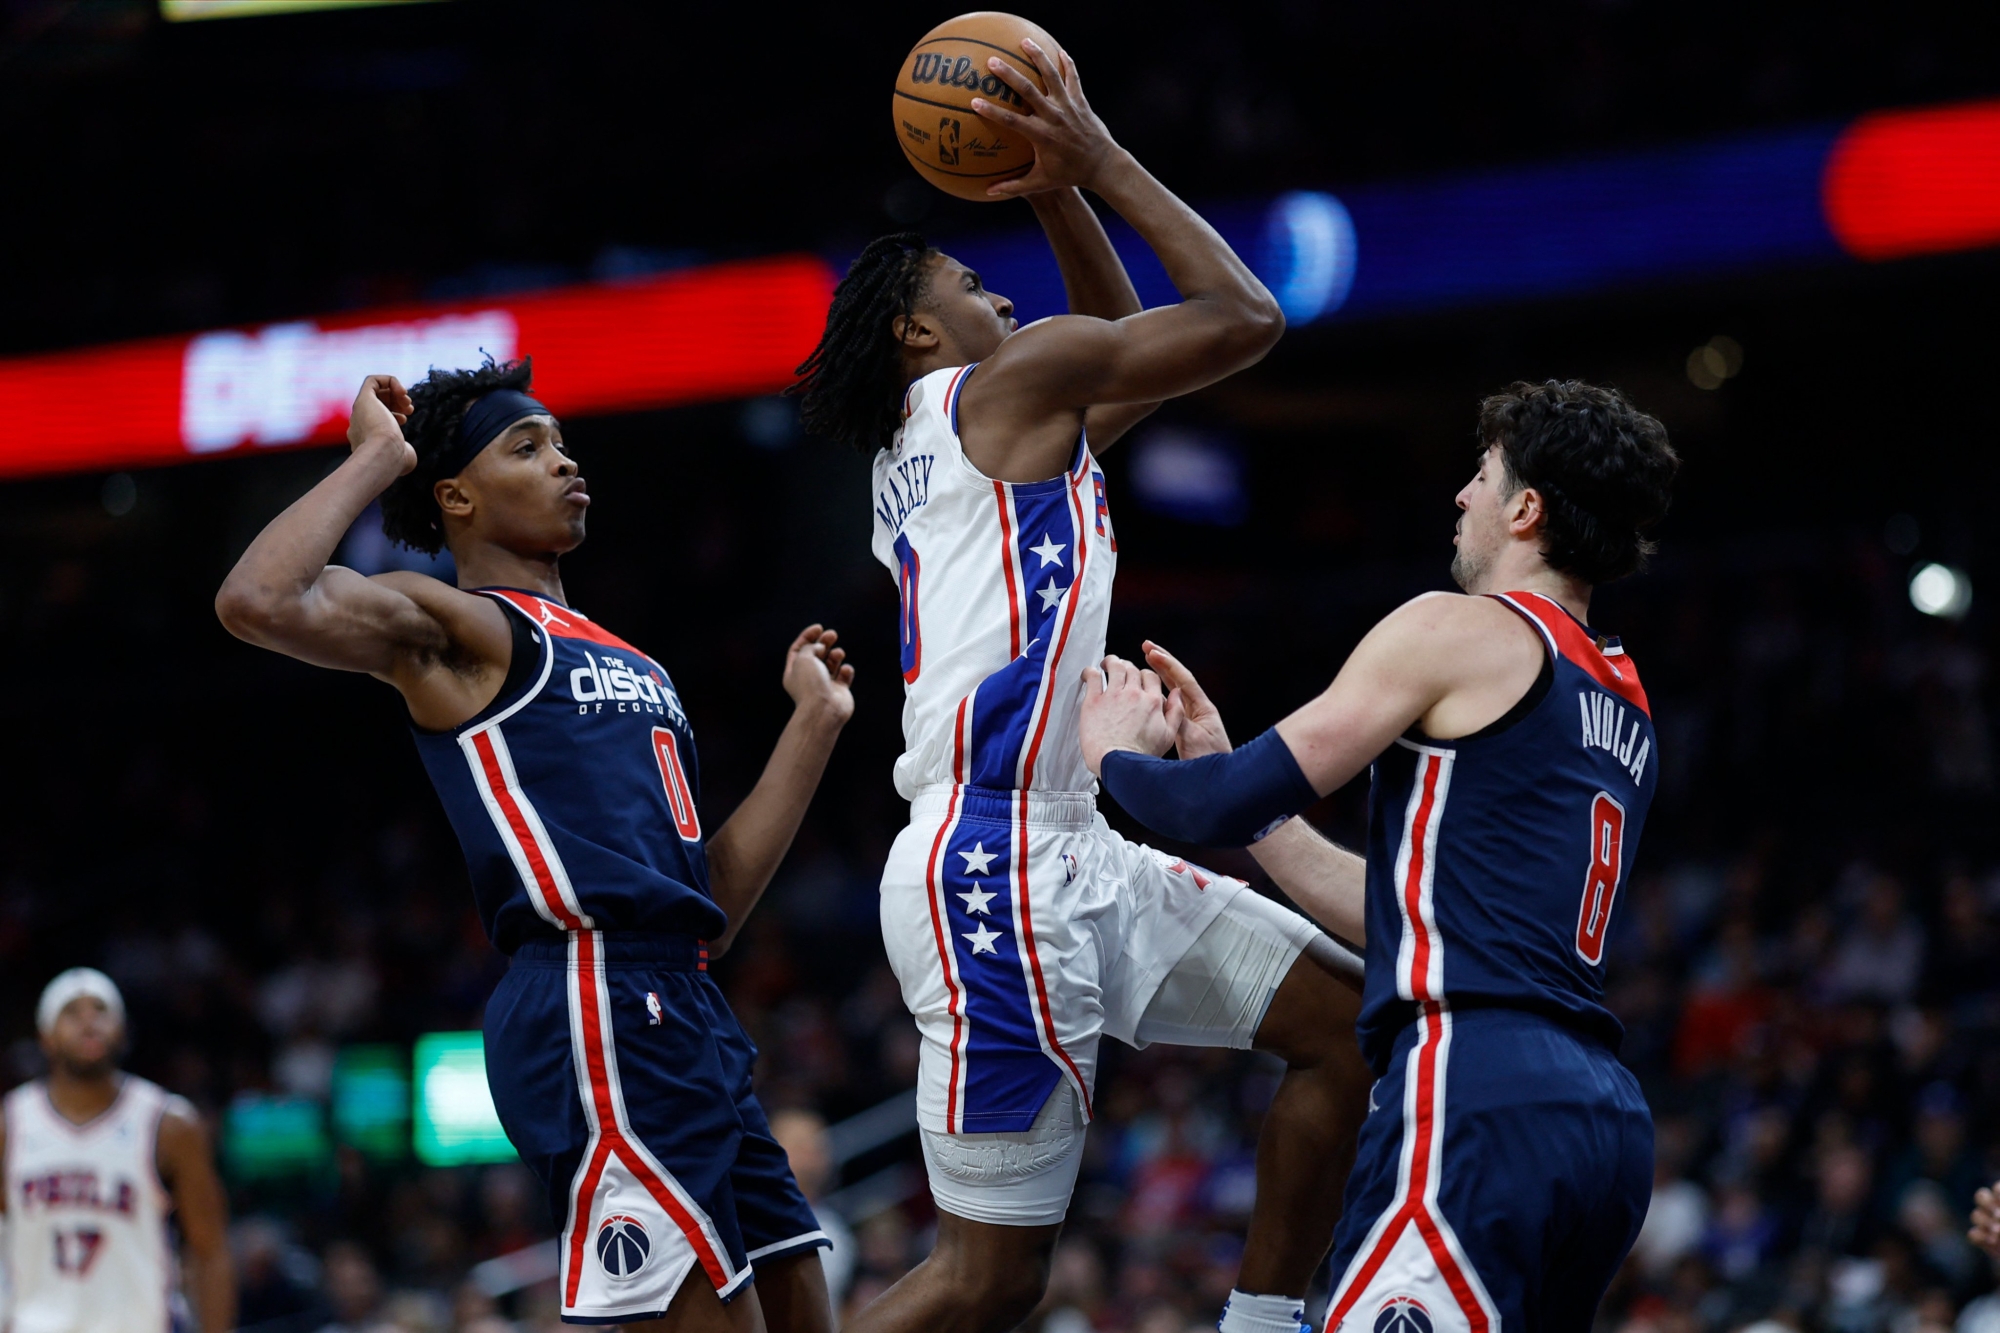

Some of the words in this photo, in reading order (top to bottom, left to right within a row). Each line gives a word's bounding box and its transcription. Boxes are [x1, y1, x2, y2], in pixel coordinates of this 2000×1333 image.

[876, 455, 934, 537] MAXEY
[893, 531, 922, 685] 0
[570, 650, 688, 721] distric
[601, 656, 627, 670] THE
[578, 703, 603, 715] OF
[1578, 691, 1651, 787] AVDIJA
[652, 726, 701, 842] 0
[1576, 790, 1626, 967] 8
